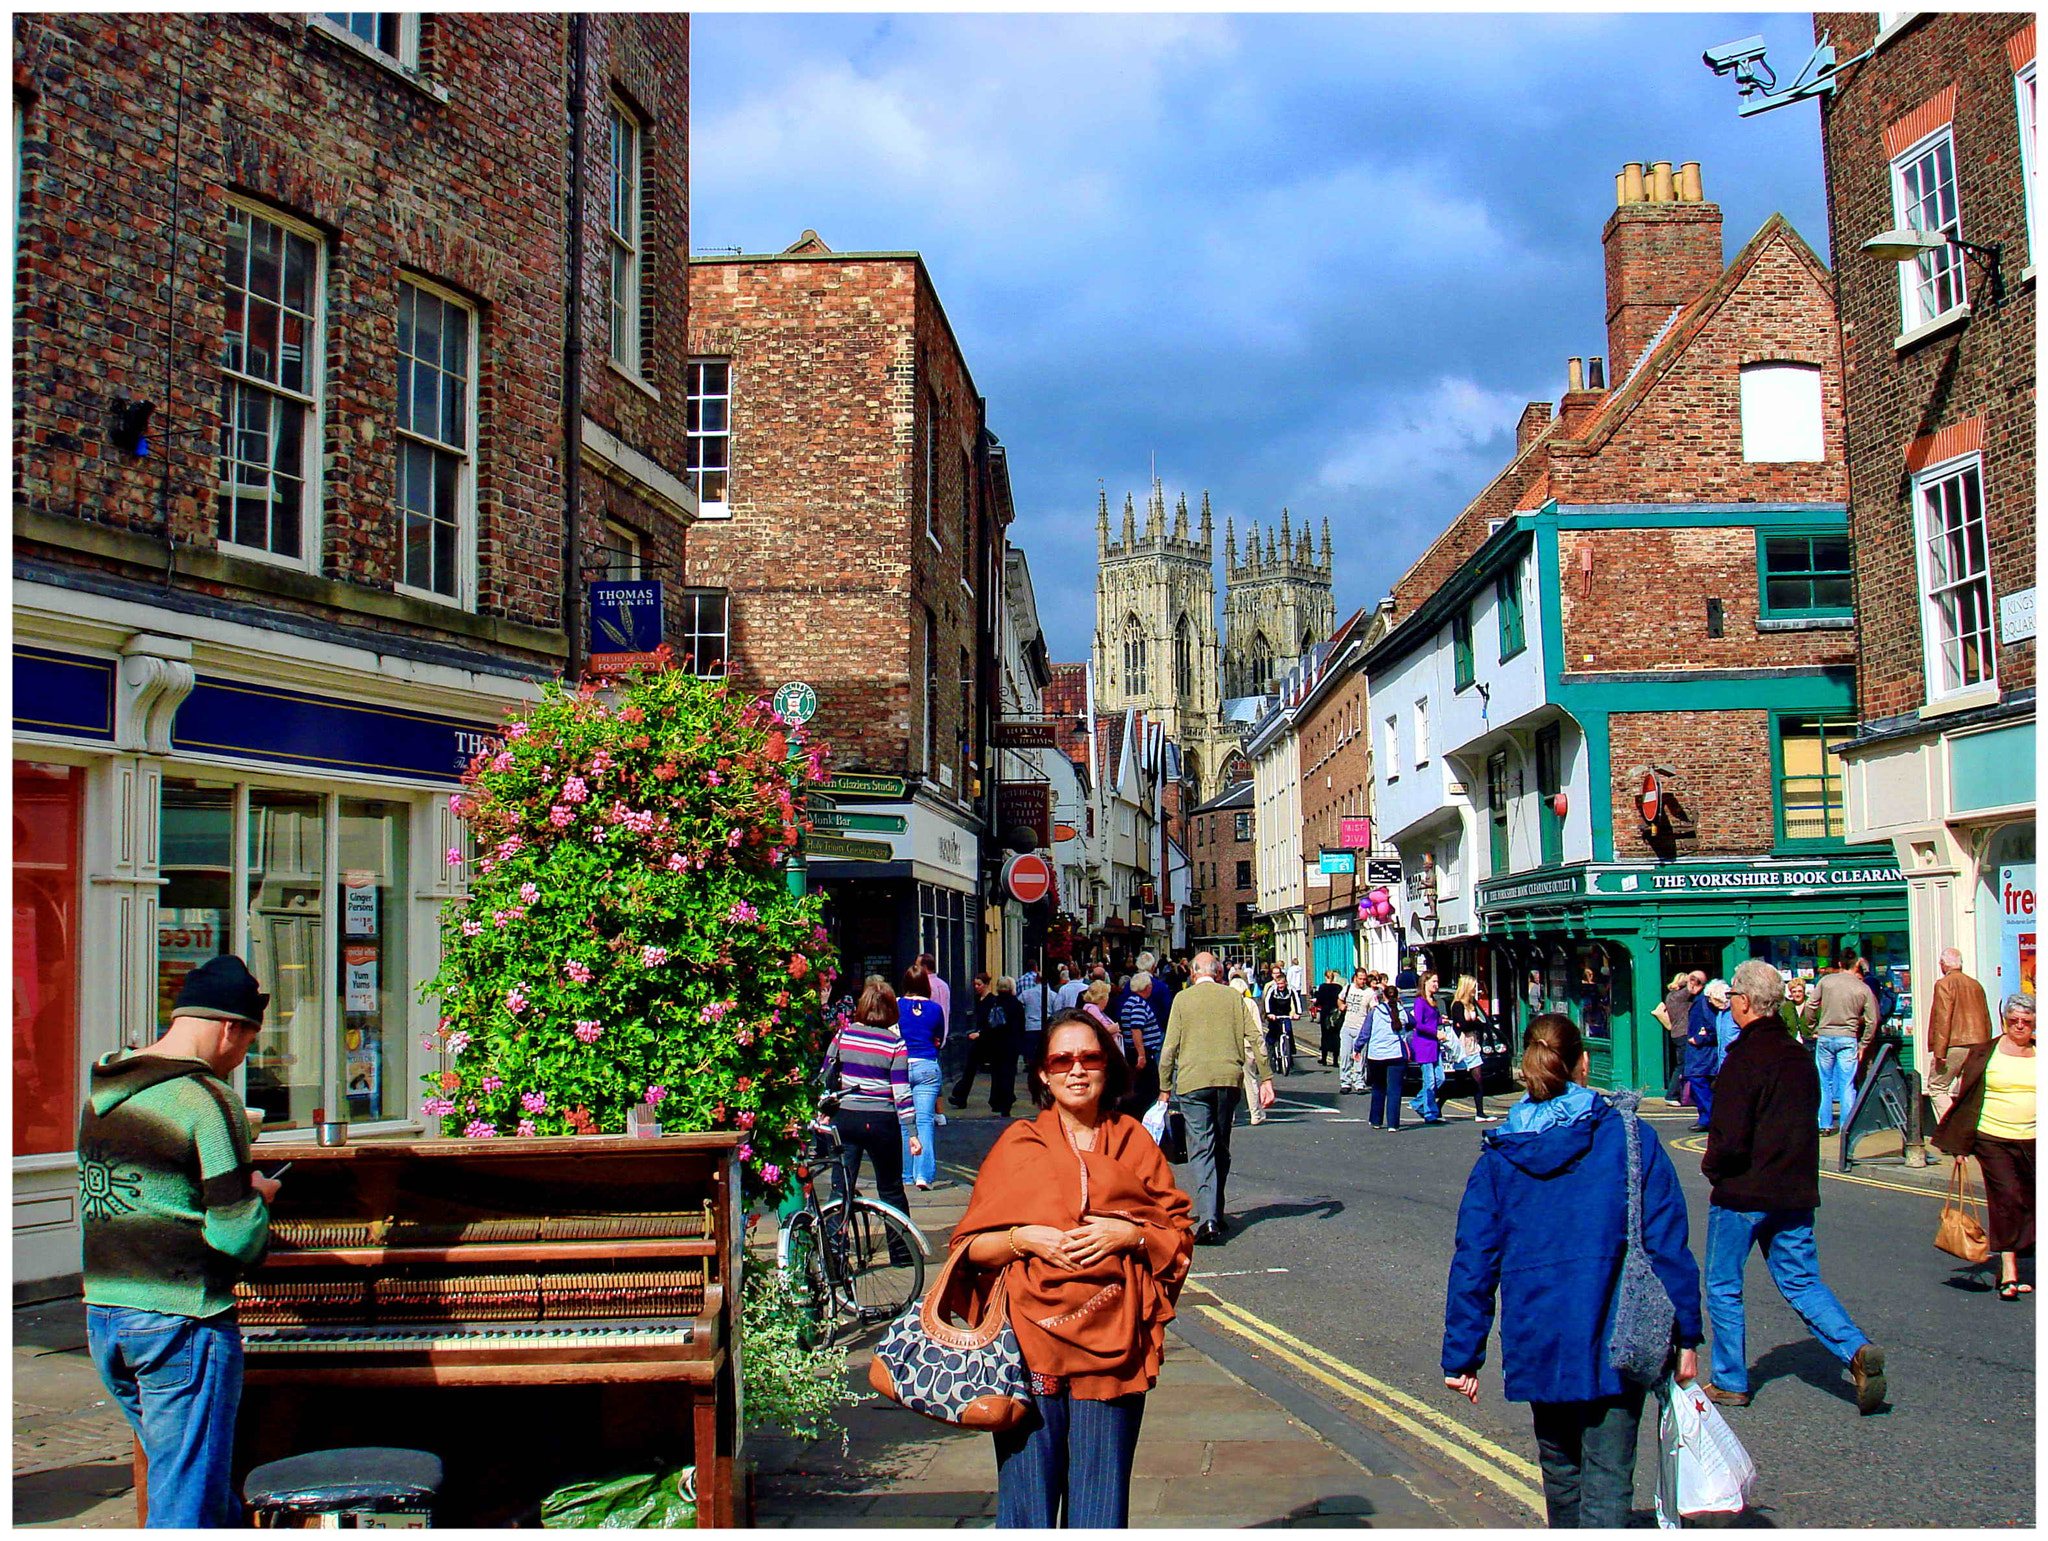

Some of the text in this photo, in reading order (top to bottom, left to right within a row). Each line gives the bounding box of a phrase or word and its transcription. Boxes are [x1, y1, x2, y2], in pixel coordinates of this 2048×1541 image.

[597, 589, 653, 600] THOMAS
[608, 598, 654, 606] BAKER
[2004, 614, 2036, 638] SQUAR
[1006, 727, 1046, 736] ROYAL
[838, 778, 871, 790] Glaziers
[871, 780, 898, 792] Studio
[808, 813, 851, 826] Monk Bar
[1653, 868, 1908, 888] THE YORKSHIRE BOOK CLEARAN
[1528, 881, 1552, 895] CLEARANCE
[1552, 879, 1570, 892] OUTLET
[350, 892, 372, 904] Ginger
[2004, 882, 2036, 915] fre
[348, 902, 374, 912] Persons
[353, 970, 368, 980] Yum
[352, 980, 370, 989] Yums
